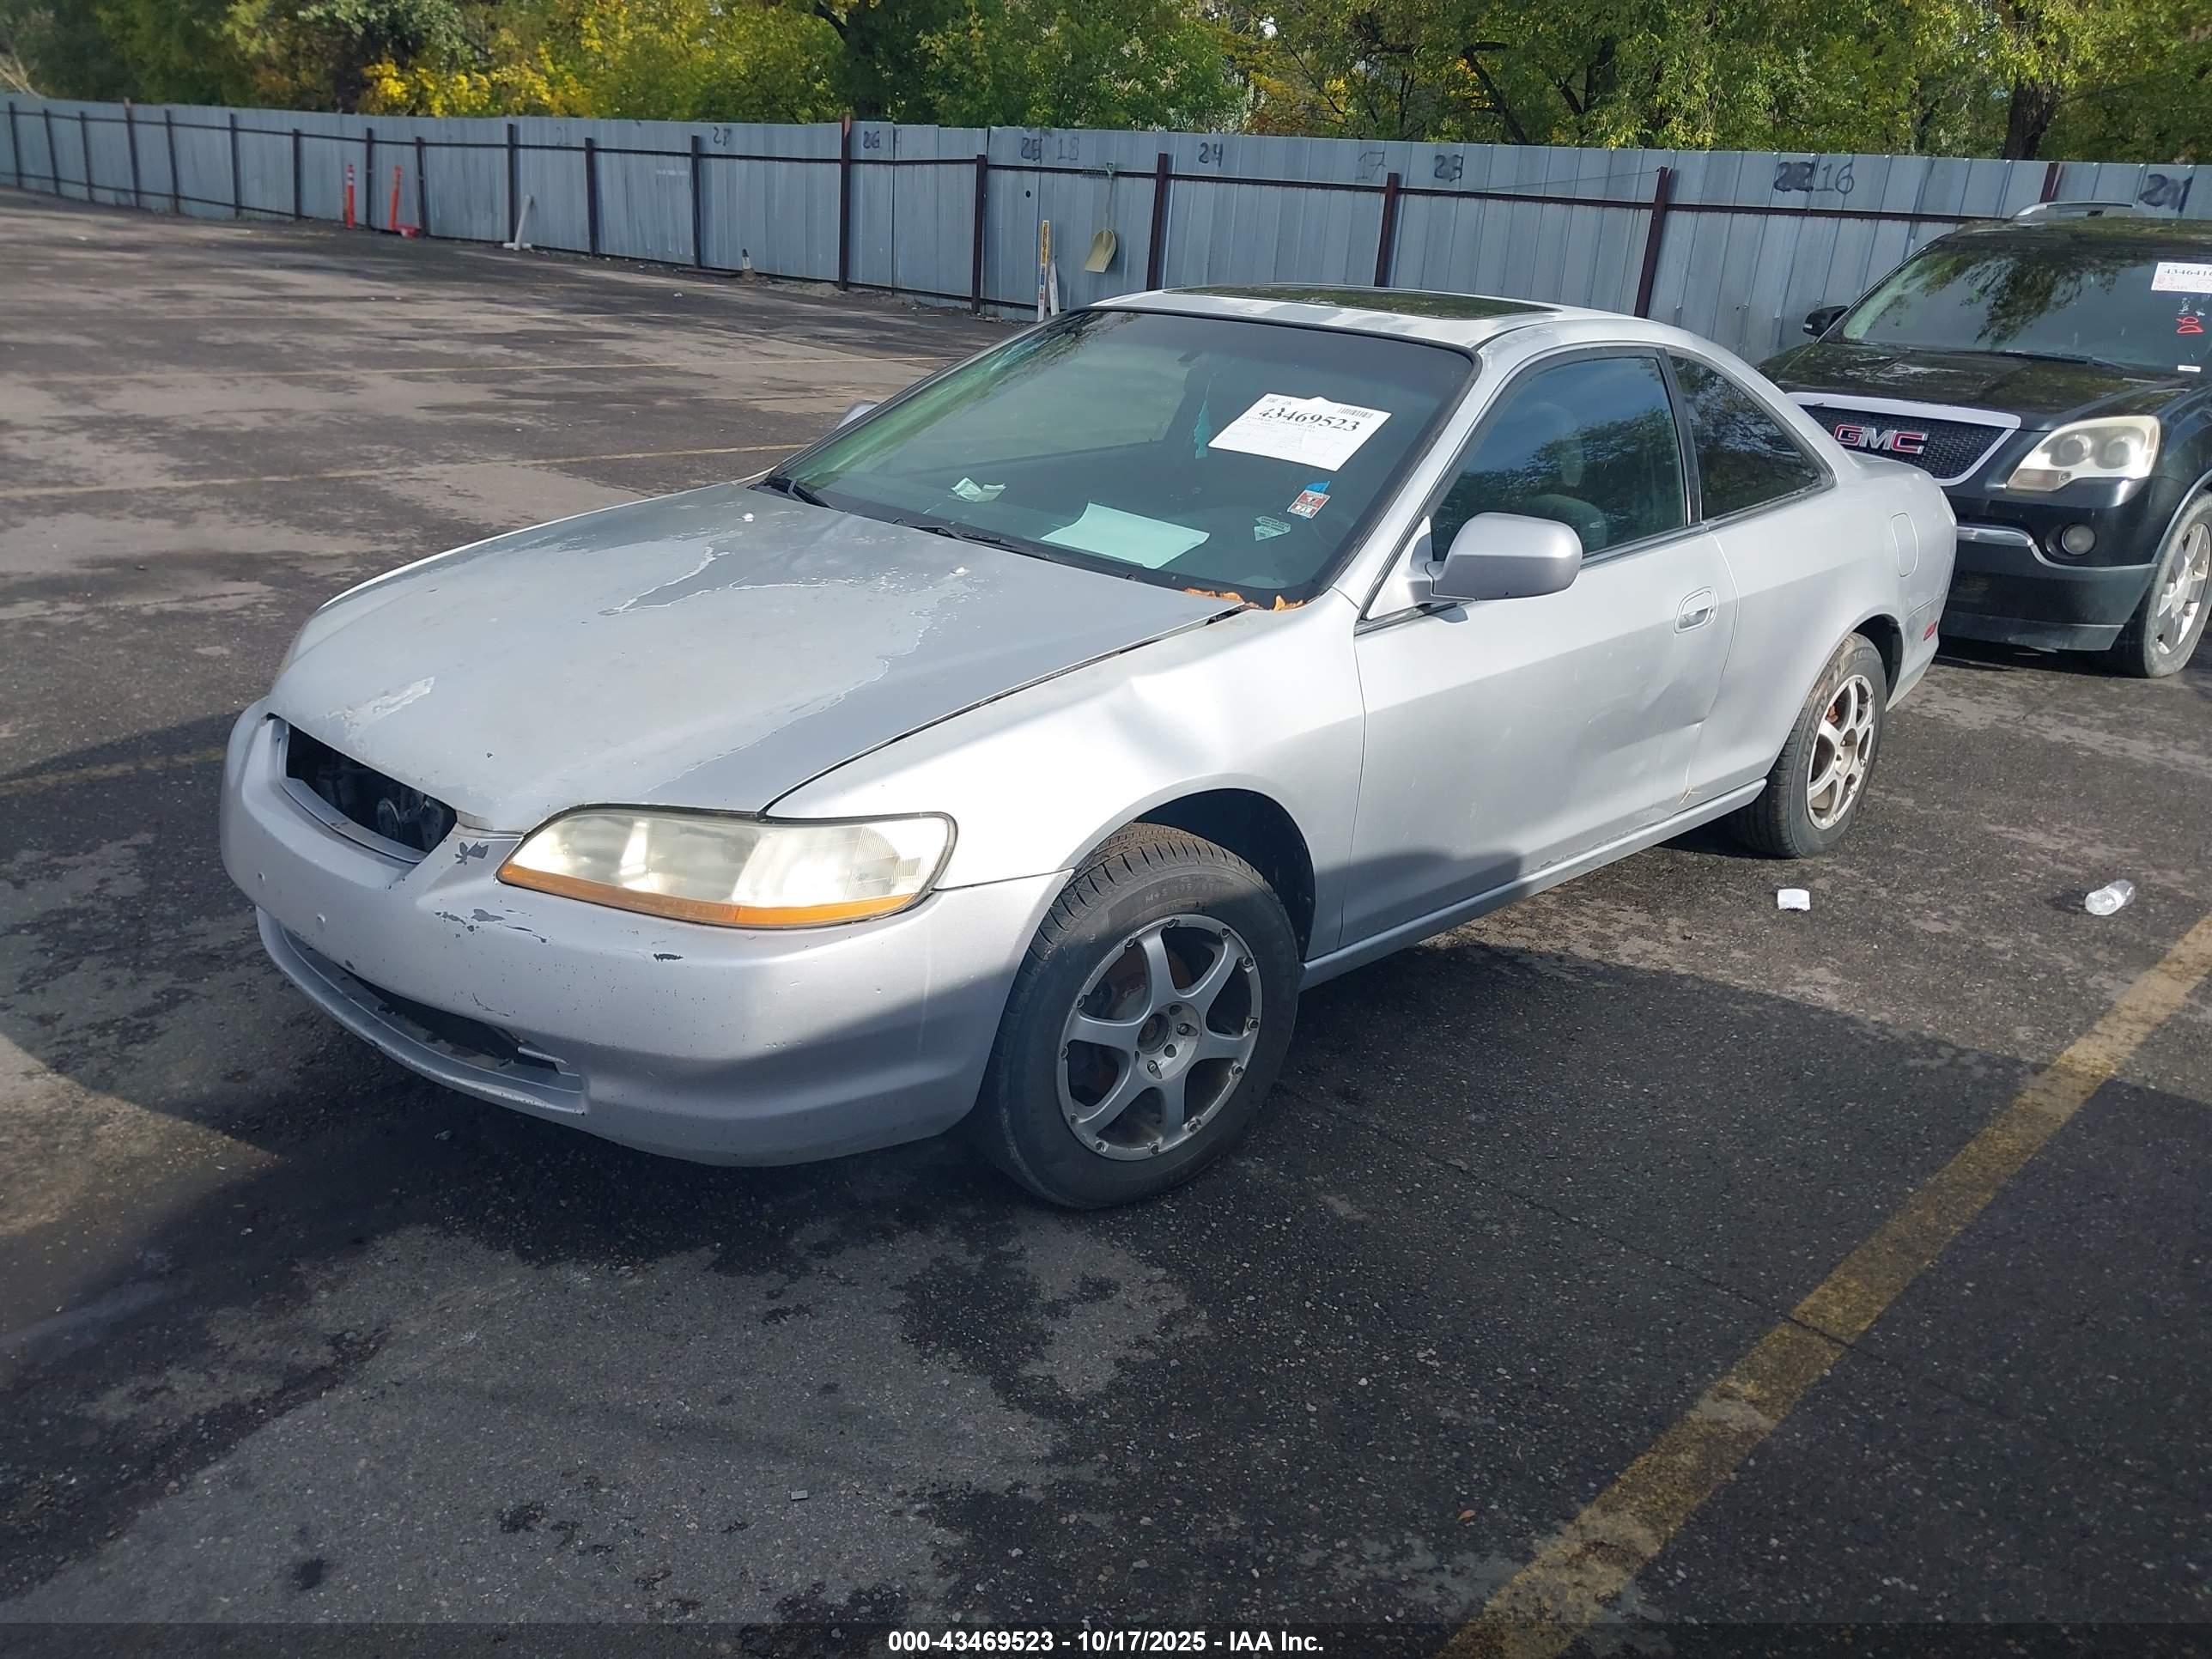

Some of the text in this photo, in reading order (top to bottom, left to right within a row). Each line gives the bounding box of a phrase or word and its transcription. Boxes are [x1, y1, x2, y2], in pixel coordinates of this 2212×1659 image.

[1198, 142, 1224, 167] 24
[1356, 151, 1387, 180] 17
[1814, 162, 1855, 194] 16
[1258, 406, 1361, 432] 43469523
[1835, 423, 1929, 454] GMC
